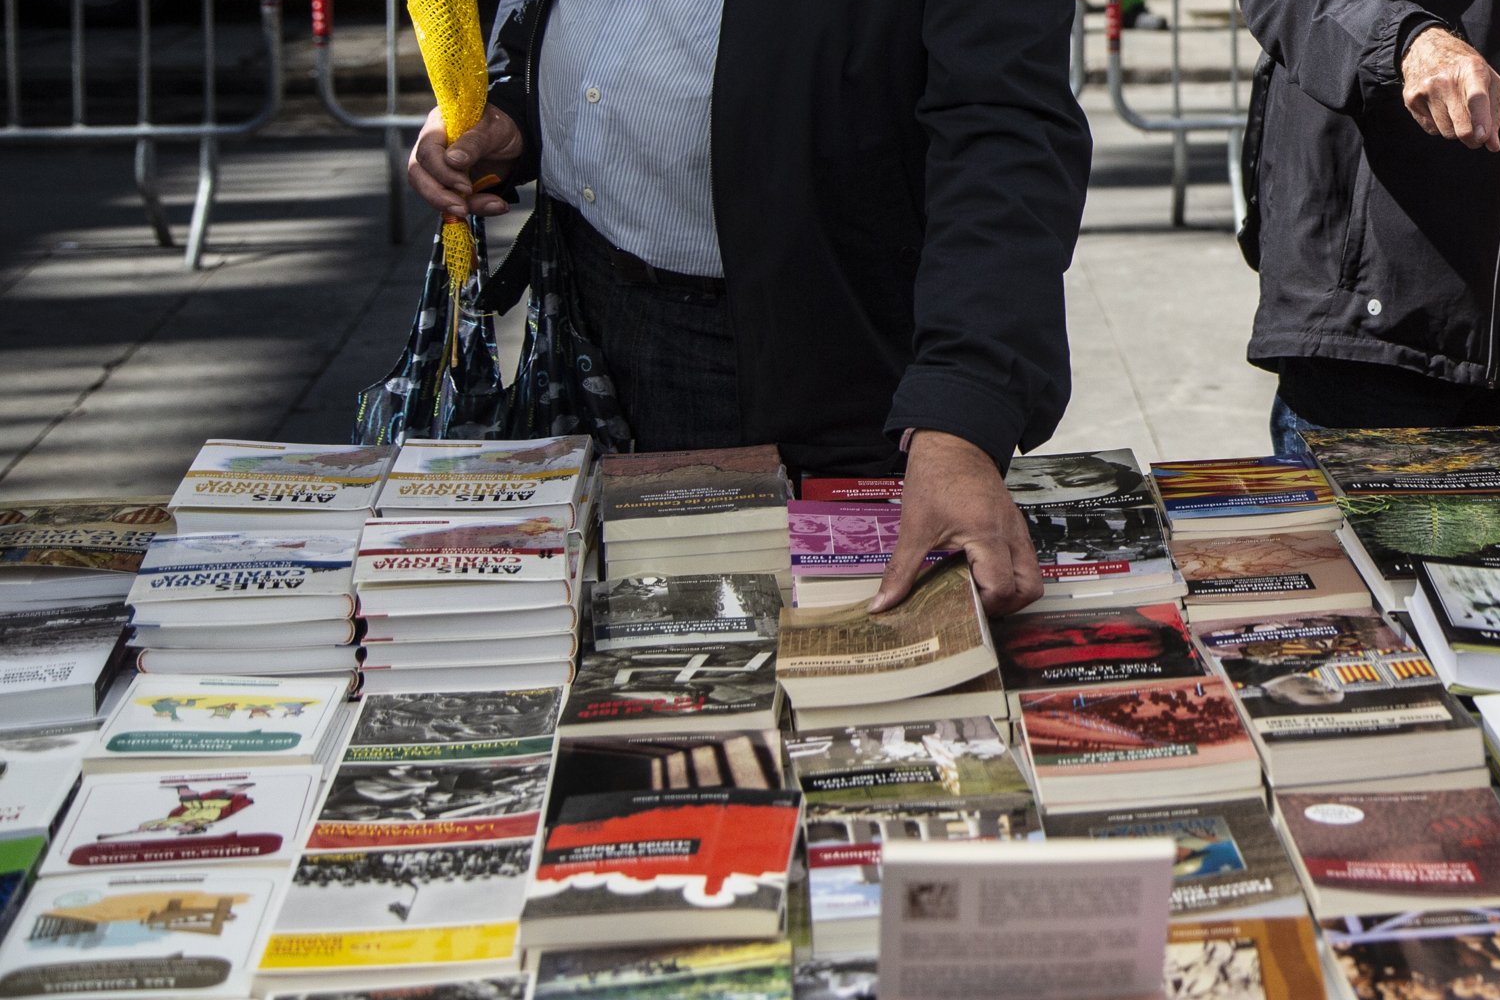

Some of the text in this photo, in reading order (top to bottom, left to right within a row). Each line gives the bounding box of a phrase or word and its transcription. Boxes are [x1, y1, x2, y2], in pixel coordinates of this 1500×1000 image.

[207, 480, 337, 492] CATALUNYA
[411, 482, 537, 490] CATALUNYA
[252, 494, 334, 503] ATLES
[455, 494, 534, 502] ATLES
[615, 500, 680, 509] Catalunya
[384, 556, 522, 564] CATALUNYA
[163, 569, 304, 581] CATALUNYA
[215, 581, 303, 591] ATLES
[1216, 637, 1264, 645] bandera
[868, 647, 929, 663] Barcelona
[790, 659, 850, 667] Catalunya
